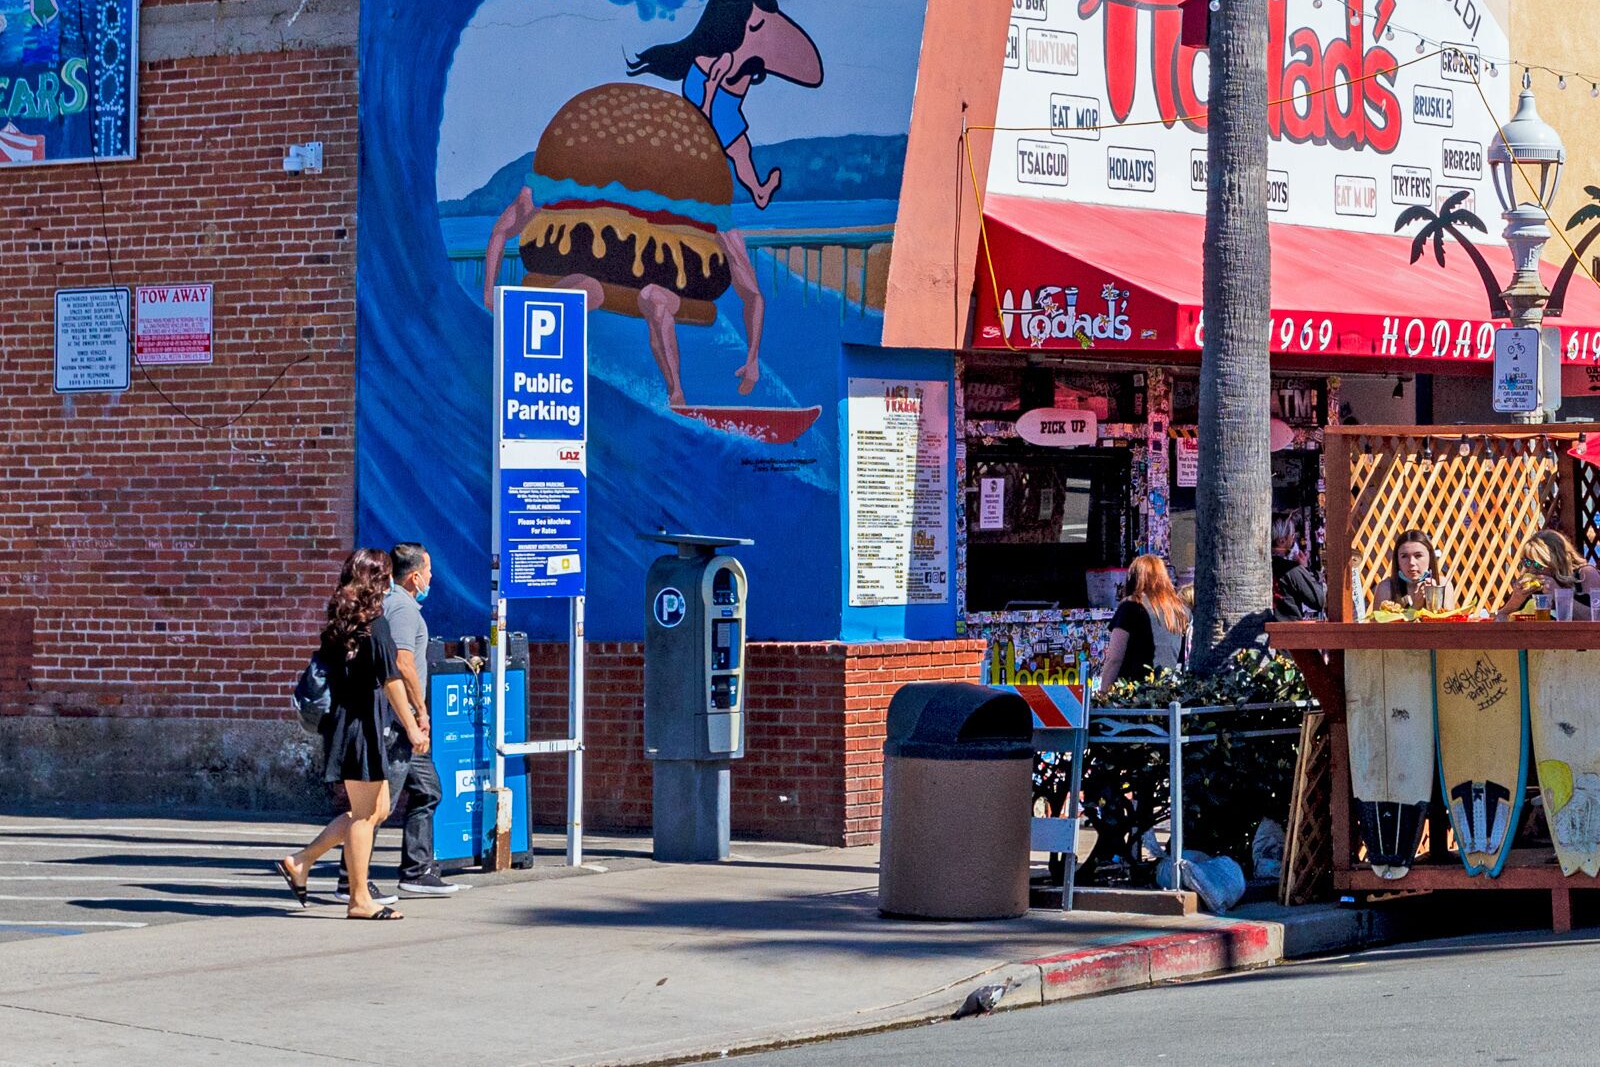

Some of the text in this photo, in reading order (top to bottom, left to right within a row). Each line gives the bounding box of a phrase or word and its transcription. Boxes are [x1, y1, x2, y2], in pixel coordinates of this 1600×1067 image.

[1052, 105, 1098, 131] EAT MOR
[1019, 151, 1066, 177] TSALGUD
[1109, 157, 1153, 183] HODADYS
[141, 289, 207, 304] TOW AWAY
[1000, 288, 1131, 342] Hodad's
[531, 310, 556, 350] P
[514, 372, 573, 394] Public
[1589, 374, 1600, 382] TO
[507, 399, 580, 426] Parking
[1040, 420, 1086, 434] PICK UP
[560, 451, 579, 461] LAZ
